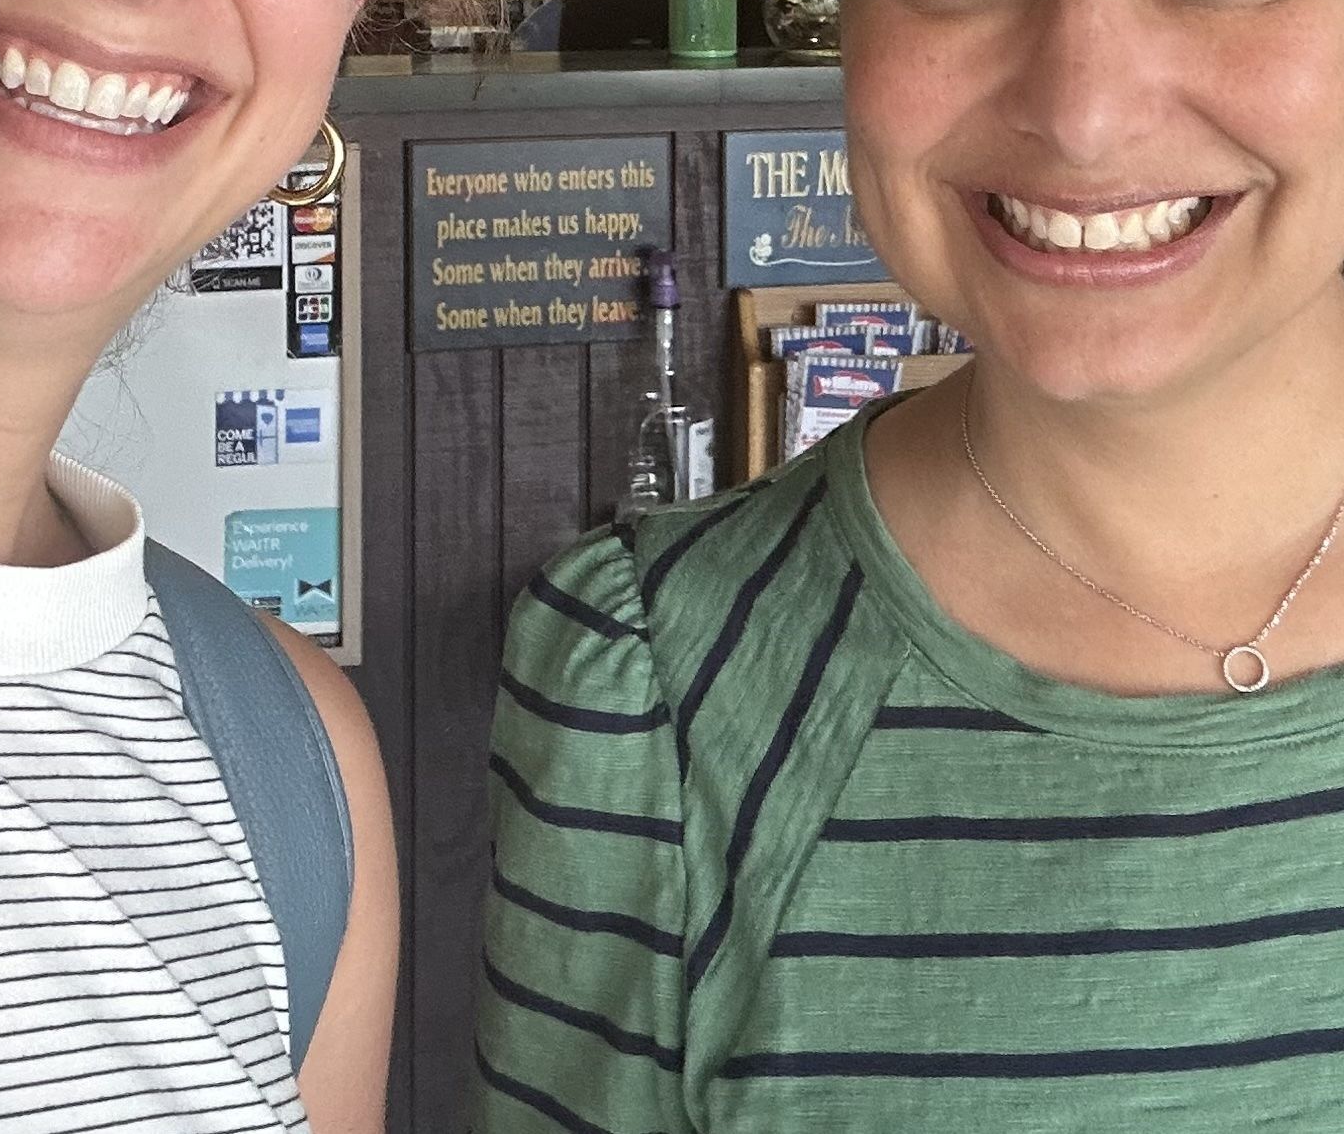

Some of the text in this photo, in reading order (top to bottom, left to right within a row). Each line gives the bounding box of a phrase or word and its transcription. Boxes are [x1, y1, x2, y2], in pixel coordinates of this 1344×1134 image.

[426, 161, 655, 202] Everyone who enters this
[745, 151, 811, 198] THE
[436, 206, 643, 248] place makes us happy.
[780, 205, 827, 248] The
[294, 239, 332, 251] DISCOVER
[432, 257, 484, 286] Some
[489, 255, 539, 282] when
[544, 252, 583, 287] they
[222, 276, 244, 288] SCAN
[436, 301, 488, 331] Some
[493, 299, 542, 326] when
[547, 296, 587, 331] they
[217, 429, 254, 442] COME
[218, 441, 244, 454] BE A
[232, 521, 308, 538] Experience
[233, 537, 281, 552] WAITR
[232, 554, 294, 572] Delivery!
